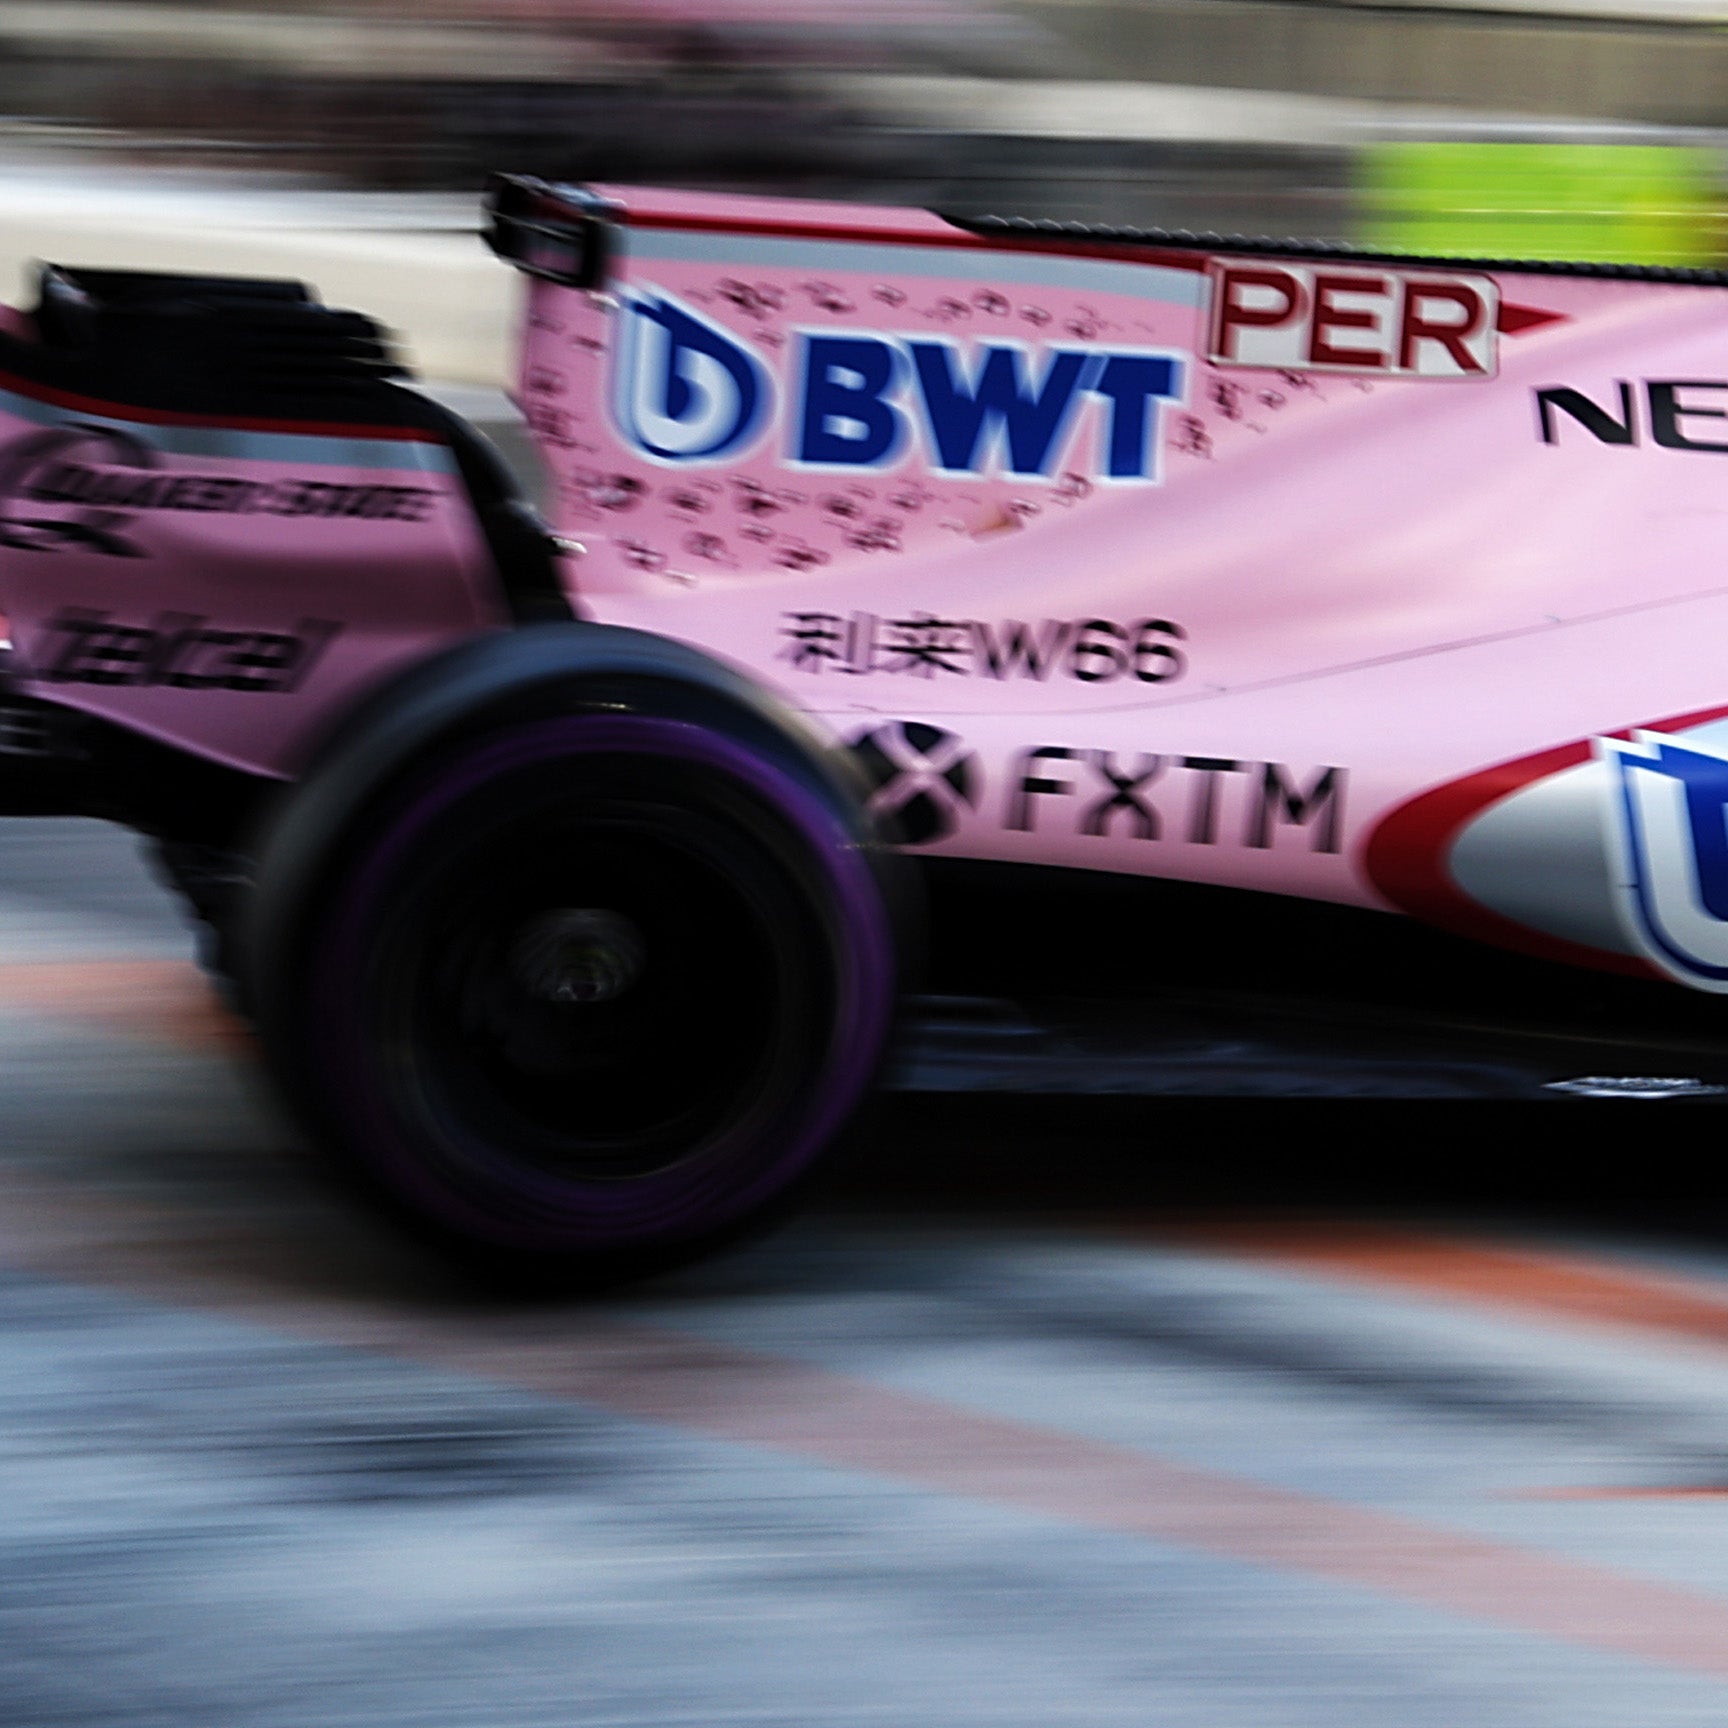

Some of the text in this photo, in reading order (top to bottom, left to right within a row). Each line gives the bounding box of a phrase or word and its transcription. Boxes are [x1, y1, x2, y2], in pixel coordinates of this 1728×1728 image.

[1217, 267, 1488, 375] PER
[793, 330, 1184, 482] BWT
[1003, 744, 1350, 855] FXTM
